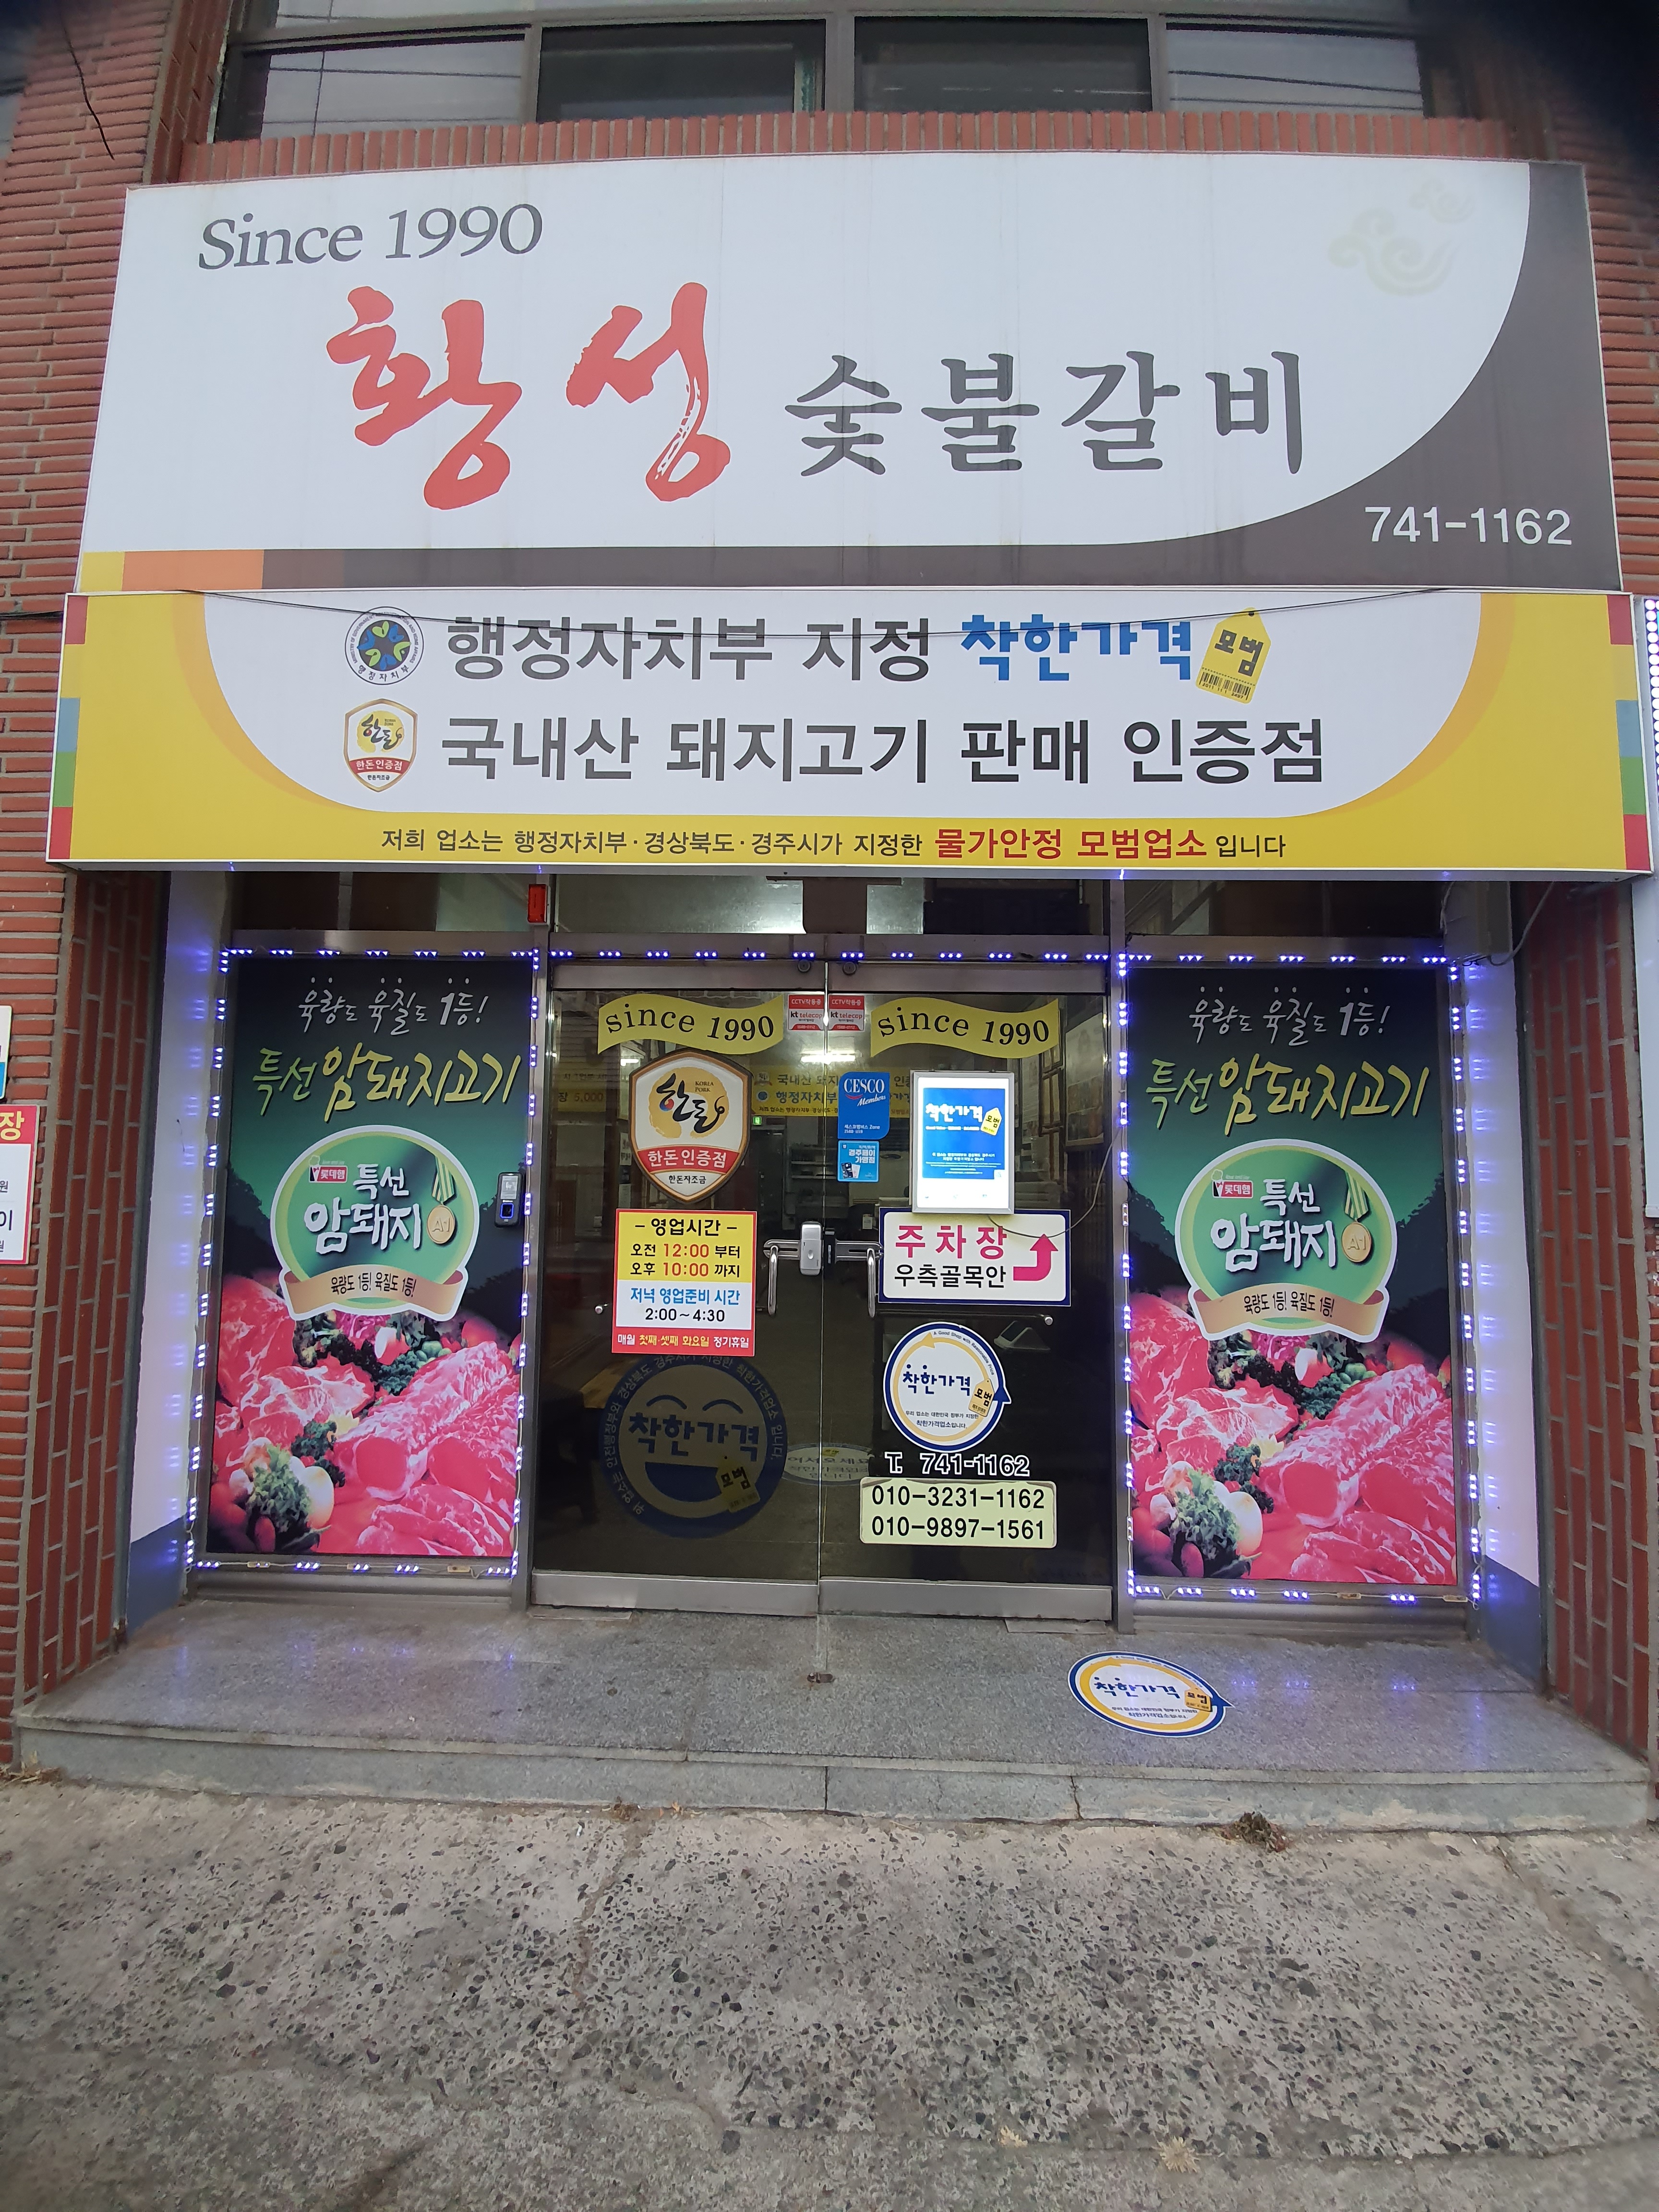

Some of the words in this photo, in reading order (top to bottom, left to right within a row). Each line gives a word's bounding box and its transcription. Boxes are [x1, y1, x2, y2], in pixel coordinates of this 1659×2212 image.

[198, 212, 363, 269] Since
[385, 203, 542, 259] 1990
[785, 350, 1301, 476] 숯불갈비
[1365, 505, 1573, 546] 741-1162
[447, 616, 772, 680] 행정자치부
[803, 617, 928, 681] 지정
[960, 613, 1190, 681] 착한가격
[1214, 629, 1263, 676] 모범
[443, 717, 638, 781] 국내산
[667, 718, 926, 783] 돼지고기
[961, 719, 1088, 783] 판매
[1124, 719, 1322, 783] 인증점
[381, 829, 424, 851] 저희
[437, 829, 503, 852] 업소는
[854, 833, 923, 856] 지정한
[934, 828, 1062, 860] 물가안정
[1077, 829, 1207, 860] 모범업소
[1215, 835, 1286, 858] 입니다
[299, 990, 357, 1033] 육량도
[369, 989, 427, 1035] 육질도
[439, 992, 489, 1025] 1등!
[606, 1003, 695, 1034] since
[707, 1015, 774, 1041] 1990
[878, 1007, 969, 1037] since
[982, 1020, 1049, 1045] 1990
[1189, 999, 1252, 1043] 육량도
[1262, 998, 1327, 1046] 육질도
[1339, 1002, 1390, 1036] 1등!
[252, 1047, 317, 1116] 특선
[323, 1042, 521, 1122] 암돼지고기
[844, 1079, 885, 1093] CESCO
[1145, 1058, 1213, 1129] 특선
[1219, 1053, 1429, 1135] 암돼지고기
[857, 1094, 886, 1106] Members
[648, 1149, 679, 1167] 한돈
[681, 1149, 727, 1169] 인증점
[353, 1164, 409, 1199] 특선
[668, 1175, 707, 1184] 한돈자조금
[1260, 1178, 1321, 1215] 특선
[304, 1197, 421, 1254] 암돼지
[651, 1218, 721, 1236] 영업시간
[630, 1244, 656, 1257] 오전
[663, 1244, 709, 1258] 12:00
[715, 1245, 740, 1258] 부터
[1211, 1213, 1336, 1272] 암돼지
[331, 1274, 355, 1295] 육량도
[358, 1272, 372, 1291] 1등!
[375, 1272, 398, 1292] 육질도
[402, 1277, 417, 1298] 1등!
[630, 1262, 655, 1275] 오후
[663, 1262, 709, 1276] 10:00
[714, 1264, 740, 1277] 까지
[894, 1264, 1006, 1288] 우측골목안
[630, 1288, 655, 1303] 저녁
[660, 1288, 709, 1304] 영업준비
[714, 1290, 740, 1305] 시간
[1244, 1294, 1270, 1314] 육량도
[1273, 1291, 1286, 1310] 1등!
[1290, 1291, 1315, 1311] 육질도
[1320, 1297, 1334, 1317] 1등!
[618, 1334, 635, 1345] 매월
[683, 1335, 709, 1347] 화요일
[714, 1336, 749, 1348] 정기휴일
[617, 1364, 652, 1399] 경상북도
[902, 1365, 971, 1396] 착한가격
[974, 1388, 992, 1407] 모범
[628, 1412, 759, 1462] 착한가격
[721, 1467, 751, 1490] 모범
[885, 1451, 903, 1474] T.
[920, 1453, 1030, 1477] 741-1162
[872, 1485, 1044, 1509] 010-3231-1162
[872, 1516, 1044, 1539] 010-9897-1561
[1094, 1677, 1180, 1698] 착한가격
